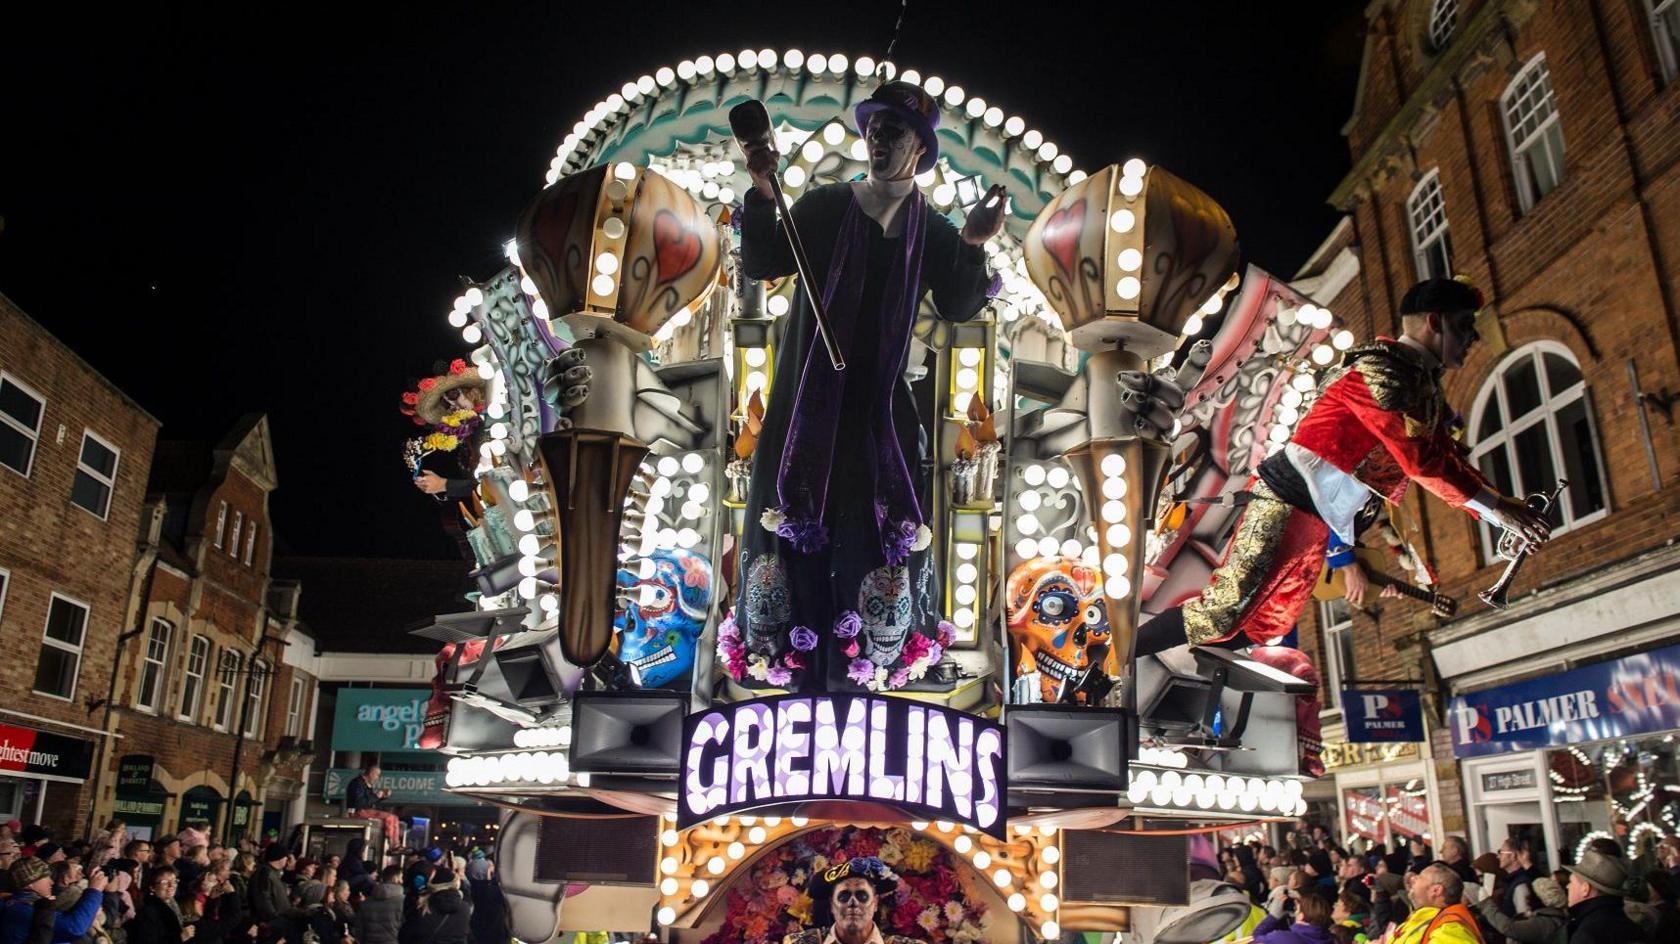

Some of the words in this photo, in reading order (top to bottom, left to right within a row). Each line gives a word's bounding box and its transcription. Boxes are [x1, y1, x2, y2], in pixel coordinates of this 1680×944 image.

[1364, 721, 1407, 730] PALMER
[1495, 689, 1600, 734] PALMER
[686, 697, 1003, 829] GREMLINS
[373, 776, 436, 791] WELCOME
